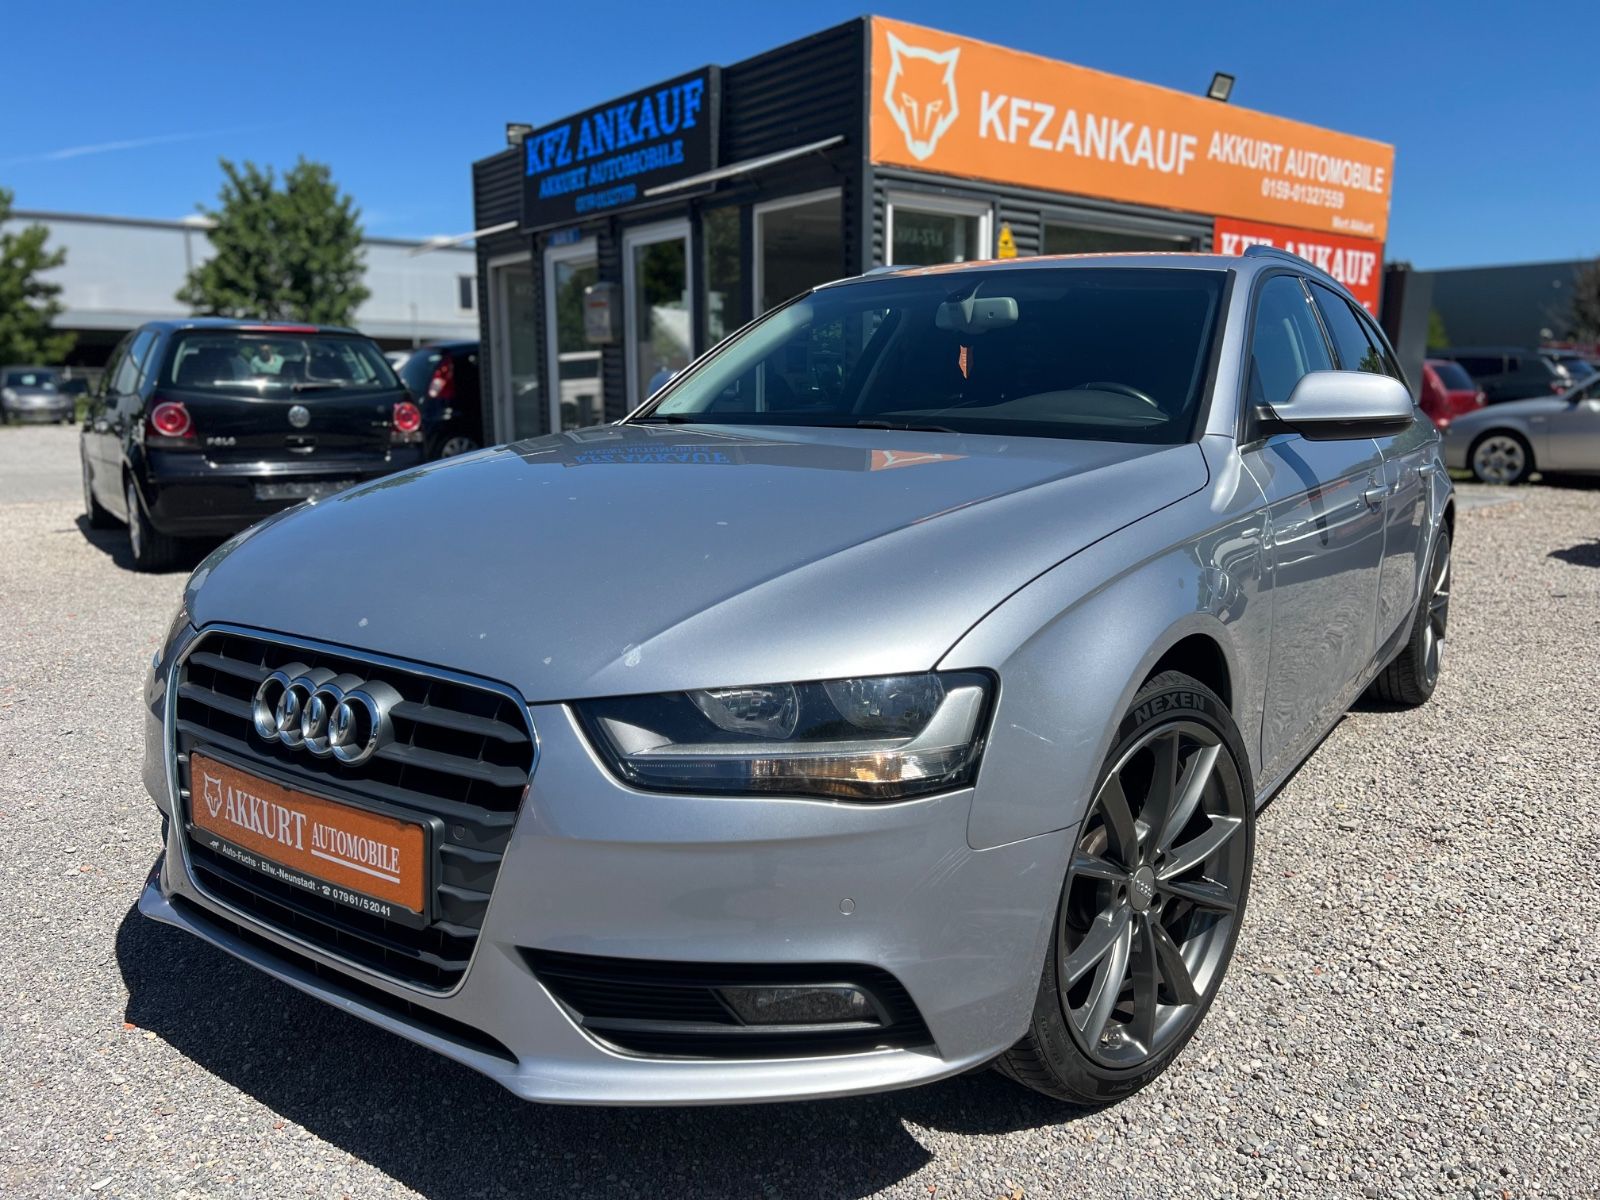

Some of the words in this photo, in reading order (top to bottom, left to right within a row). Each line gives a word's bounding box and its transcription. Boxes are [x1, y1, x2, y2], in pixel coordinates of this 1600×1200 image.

[526, 124, 572, 176] KFZ
[576, 78, 704, 161] ANKAUF
[588, 140, 684, 187] AUTOMOBILE
[1207, 131, 1283, 173] AKKURT
[1285, 148, 1385, 193] AUTOMOBILE
[1285, 241, 1376, 286] KAUF
[1134, 693, 1205, 726] NEXEN
[224, 786, 307, 850] AKKURT
[312, 822, 400, 874] AUTOMOBILE
[222, 844, 257, 868] Auto-Fuchs
